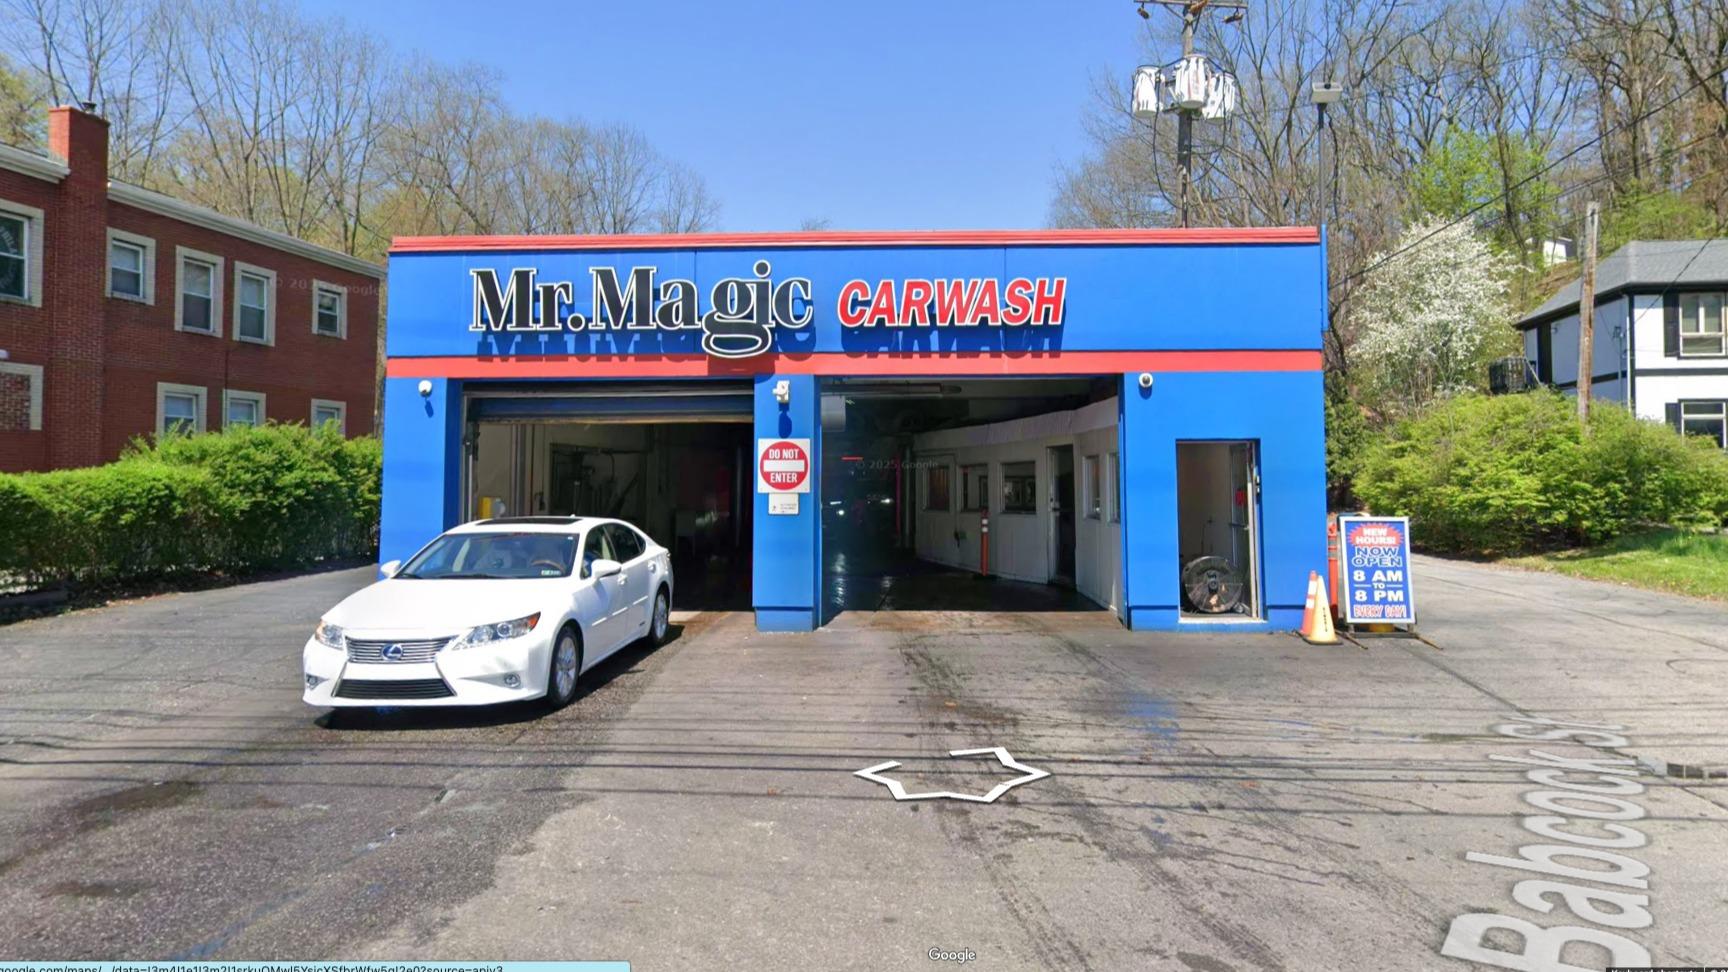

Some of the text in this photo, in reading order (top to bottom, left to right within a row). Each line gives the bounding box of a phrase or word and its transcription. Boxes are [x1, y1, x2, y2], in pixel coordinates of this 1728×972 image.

[837, 277, 1067, 328] CARWASH
[769, 448, 800, 459] DO NOT
[770, 472, 798, 484] ENTER
[1363, 527, 1388, 536] NEW
[1355, 546, 1400, 557] NOW
[1351, 557, 1403, 567] OPEN
[1353, 570, 1403, 582] 8 AM
[1354, 590, 1404, 602] 8 PM
[1353, 604, 1383, 618] EVERY
